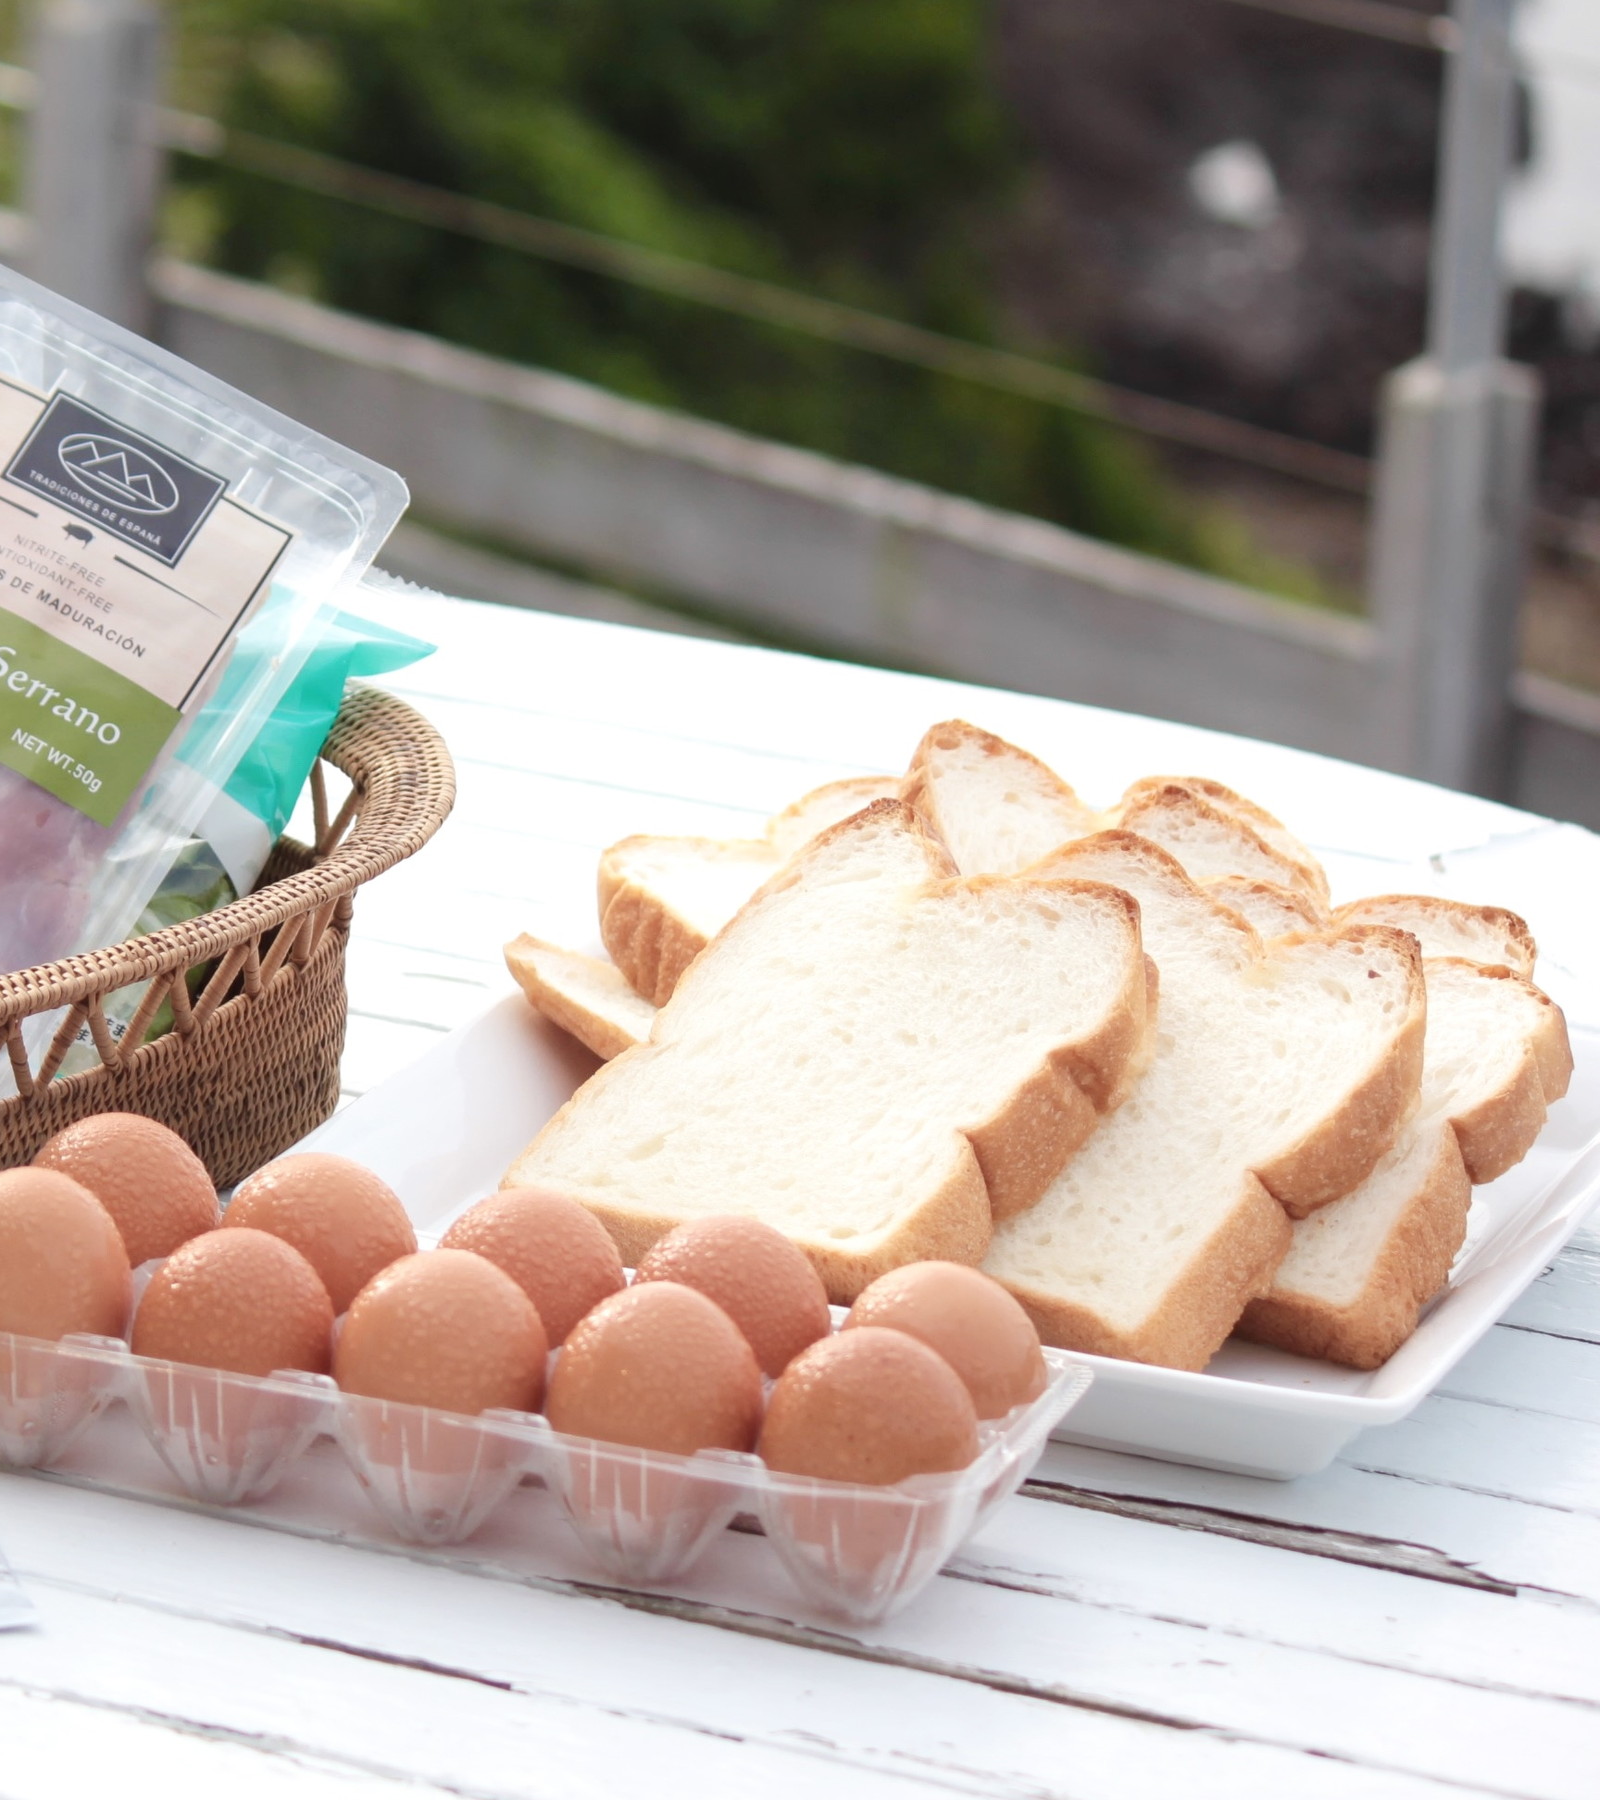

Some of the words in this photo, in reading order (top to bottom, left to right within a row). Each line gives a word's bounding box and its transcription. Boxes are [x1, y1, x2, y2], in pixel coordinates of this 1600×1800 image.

[28, 469, 99, 512] TRADICIONES
[102, 507, 117, 521] DE
[14, 533, 106, 588] NITRITE-FREE
[9, 575, 34, 594] DE
[36, 589, 146, 659] MADURACIÓN
[11, 727, 47, 756] NET
